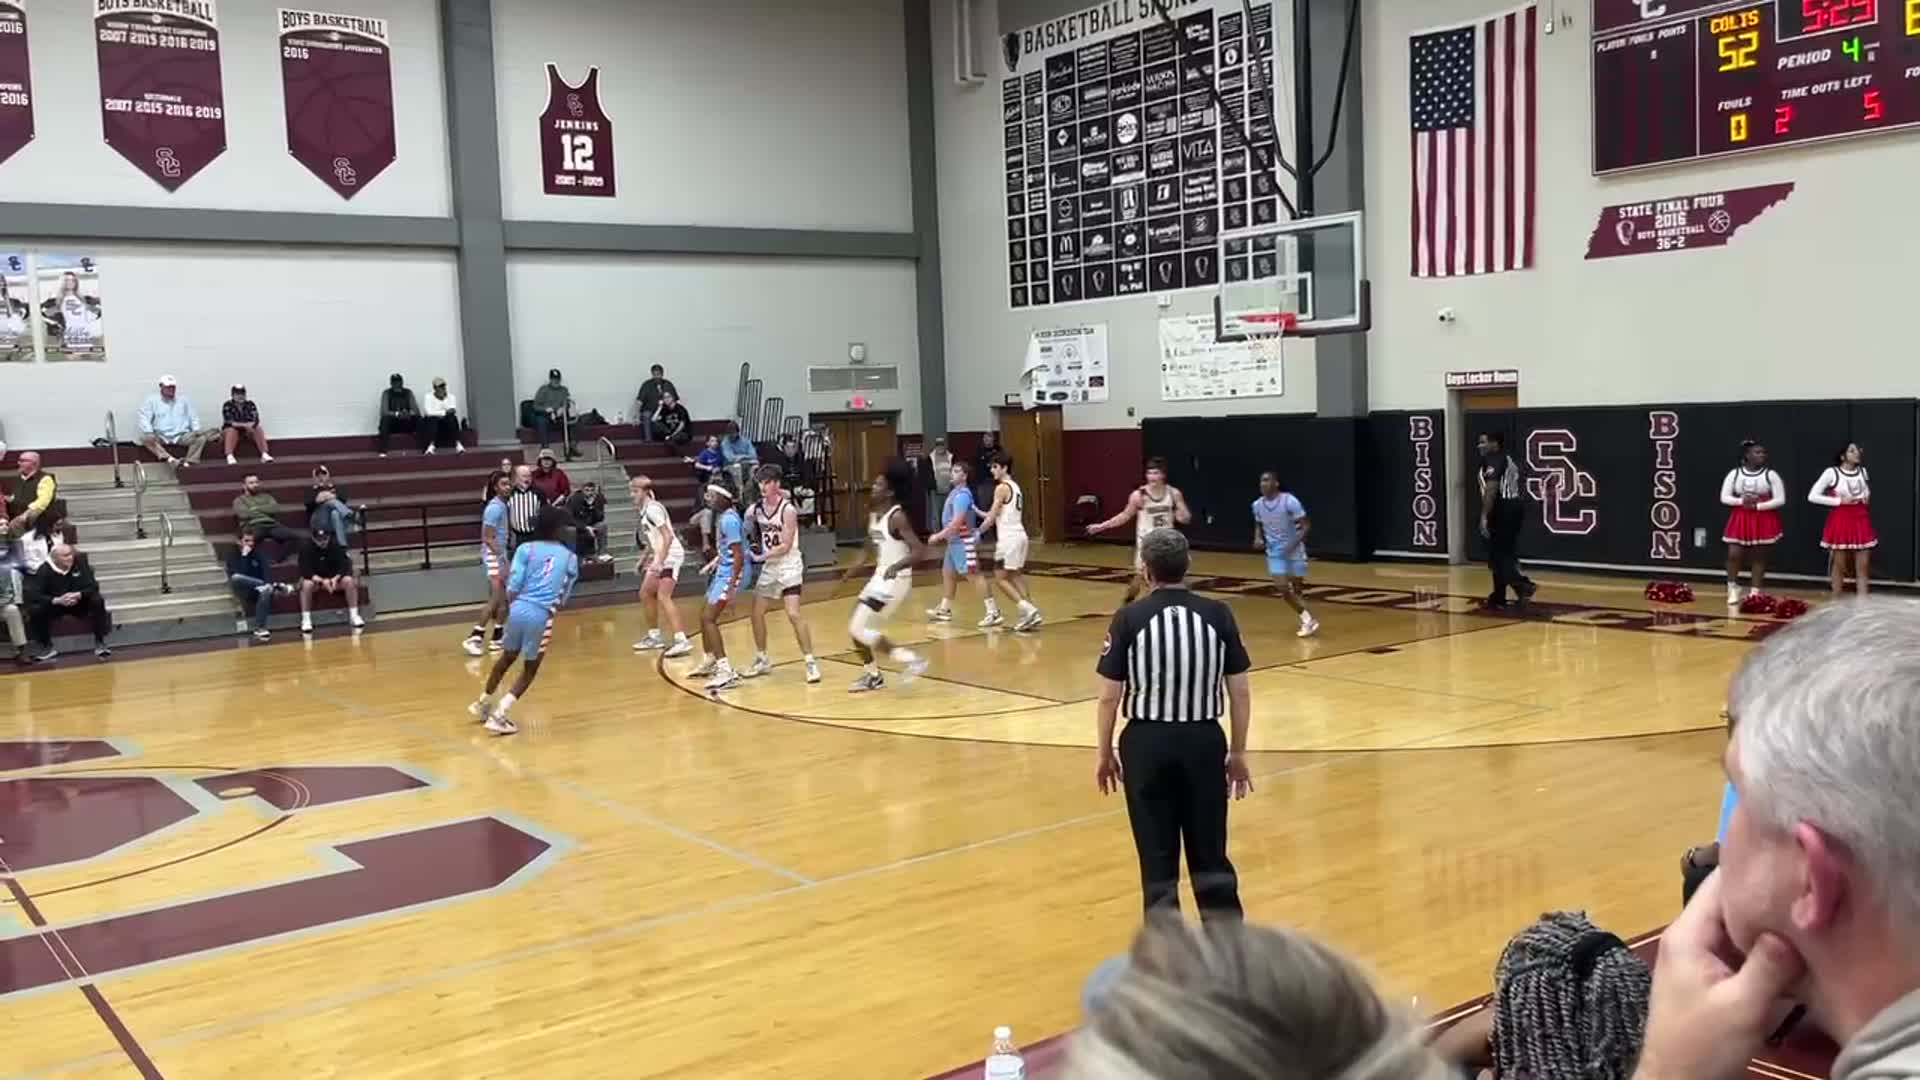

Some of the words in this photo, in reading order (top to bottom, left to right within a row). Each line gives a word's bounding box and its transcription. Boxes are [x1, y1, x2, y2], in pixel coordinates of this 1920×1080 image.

[281, 10, 310, 28] BOYS
[313, 14, 385, 38] BASKETBALL
[1024, 0, 1134, 54] BASKETBALL
[1657, 24, 1686, 39] POINTS
[1710, 10, 1760, 33] COLTS
[283, 46, 310, 59] 2016
[1718, 31, 1759, 72] 52
[1777, 48, 1832, 70] PERIOD
[1841, 36, 1860, 62] 4
[1, 92, 29, 105] 2016
[1781, 86, 1809, 100] TIME
[1811, 80, 1840, 95] OUTS
[1844, 74, 1873, 89] LEFT
[195, 105, 222, 119] 2019
[1718, 97, 1752, 112] FOULS
[1863, 92, 1881, 121] 5
[553, 120, 599, 131] JENKINS
[1775, 106, 1792, 134] 2
[561, 134, 595, 171] 12
[1183, 139, 1214, 159] VITA
[1619, 203, 1653, 218] STATE
[1656, 198, 1690, 213] FINAL
[1693, 194, 1725, 210] FOUR
[1637, 230, 1656, 240] BOYS
[1657, 224, 1705, 237] BASKETBALL
[1655, 212, 1687, 229] 2016
[1656, 236, 1686, 250] 36-2
[1410, 416, 1437, 546] BISON
[1526, 429, 1597, 534] SC
[1649, 411, 1681, 559] BISON
